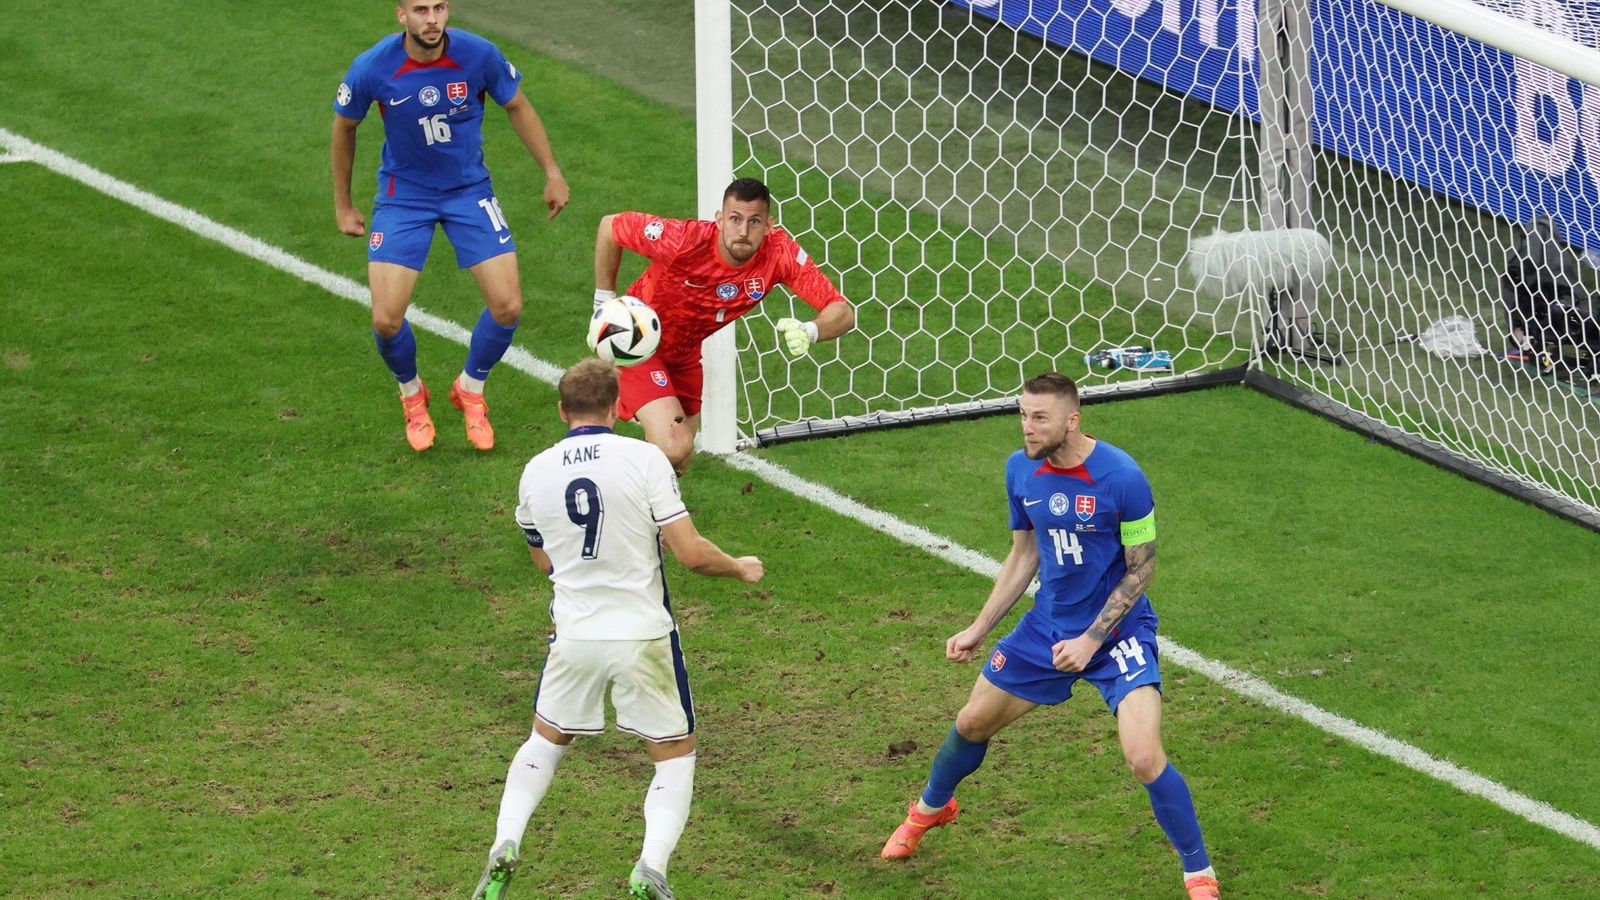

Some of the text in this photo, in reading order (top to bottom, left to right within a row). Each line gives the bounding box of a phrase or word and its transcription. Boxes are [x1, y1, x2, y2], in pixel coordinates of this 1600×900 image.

[418, 114, 452, 146] 16
[563, 444, 601, 466] KANE
[565, 477, 605, 560] 9
[1122, 527, 1147, 537] RESPECT
[1048, 529, 1083, 566] 14
[1109, 636, 1147, 674] 14
